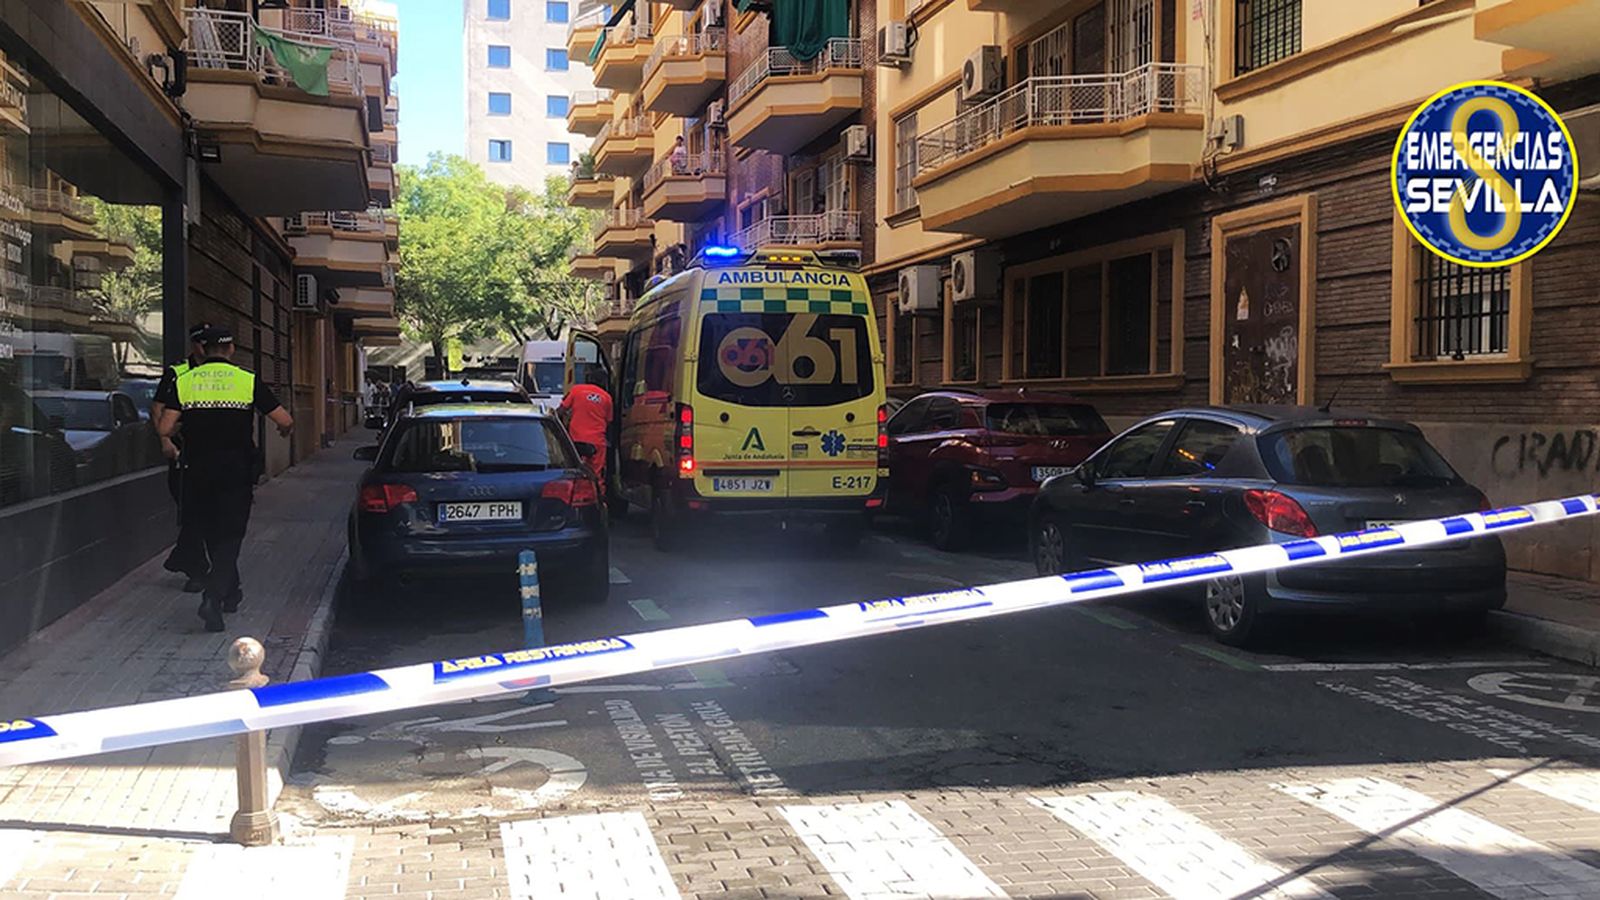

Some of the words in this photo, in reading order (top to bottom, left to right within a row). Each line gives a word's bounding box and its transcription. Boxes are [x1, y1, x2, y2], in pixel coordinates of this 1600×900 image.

[718, 271, 851, 287] AMBULANCIA
[717, 313, 858, 387] 061
[720, 478, 747, 491] 4851
[832, 476, 871, 489] E-217
[446, 504, 481, 519] 2647
[489, 503, 516, 518] FPH
[442, 654, 503, 673] AREA
[504, 637, 626, 663] RESTRINGIDA
